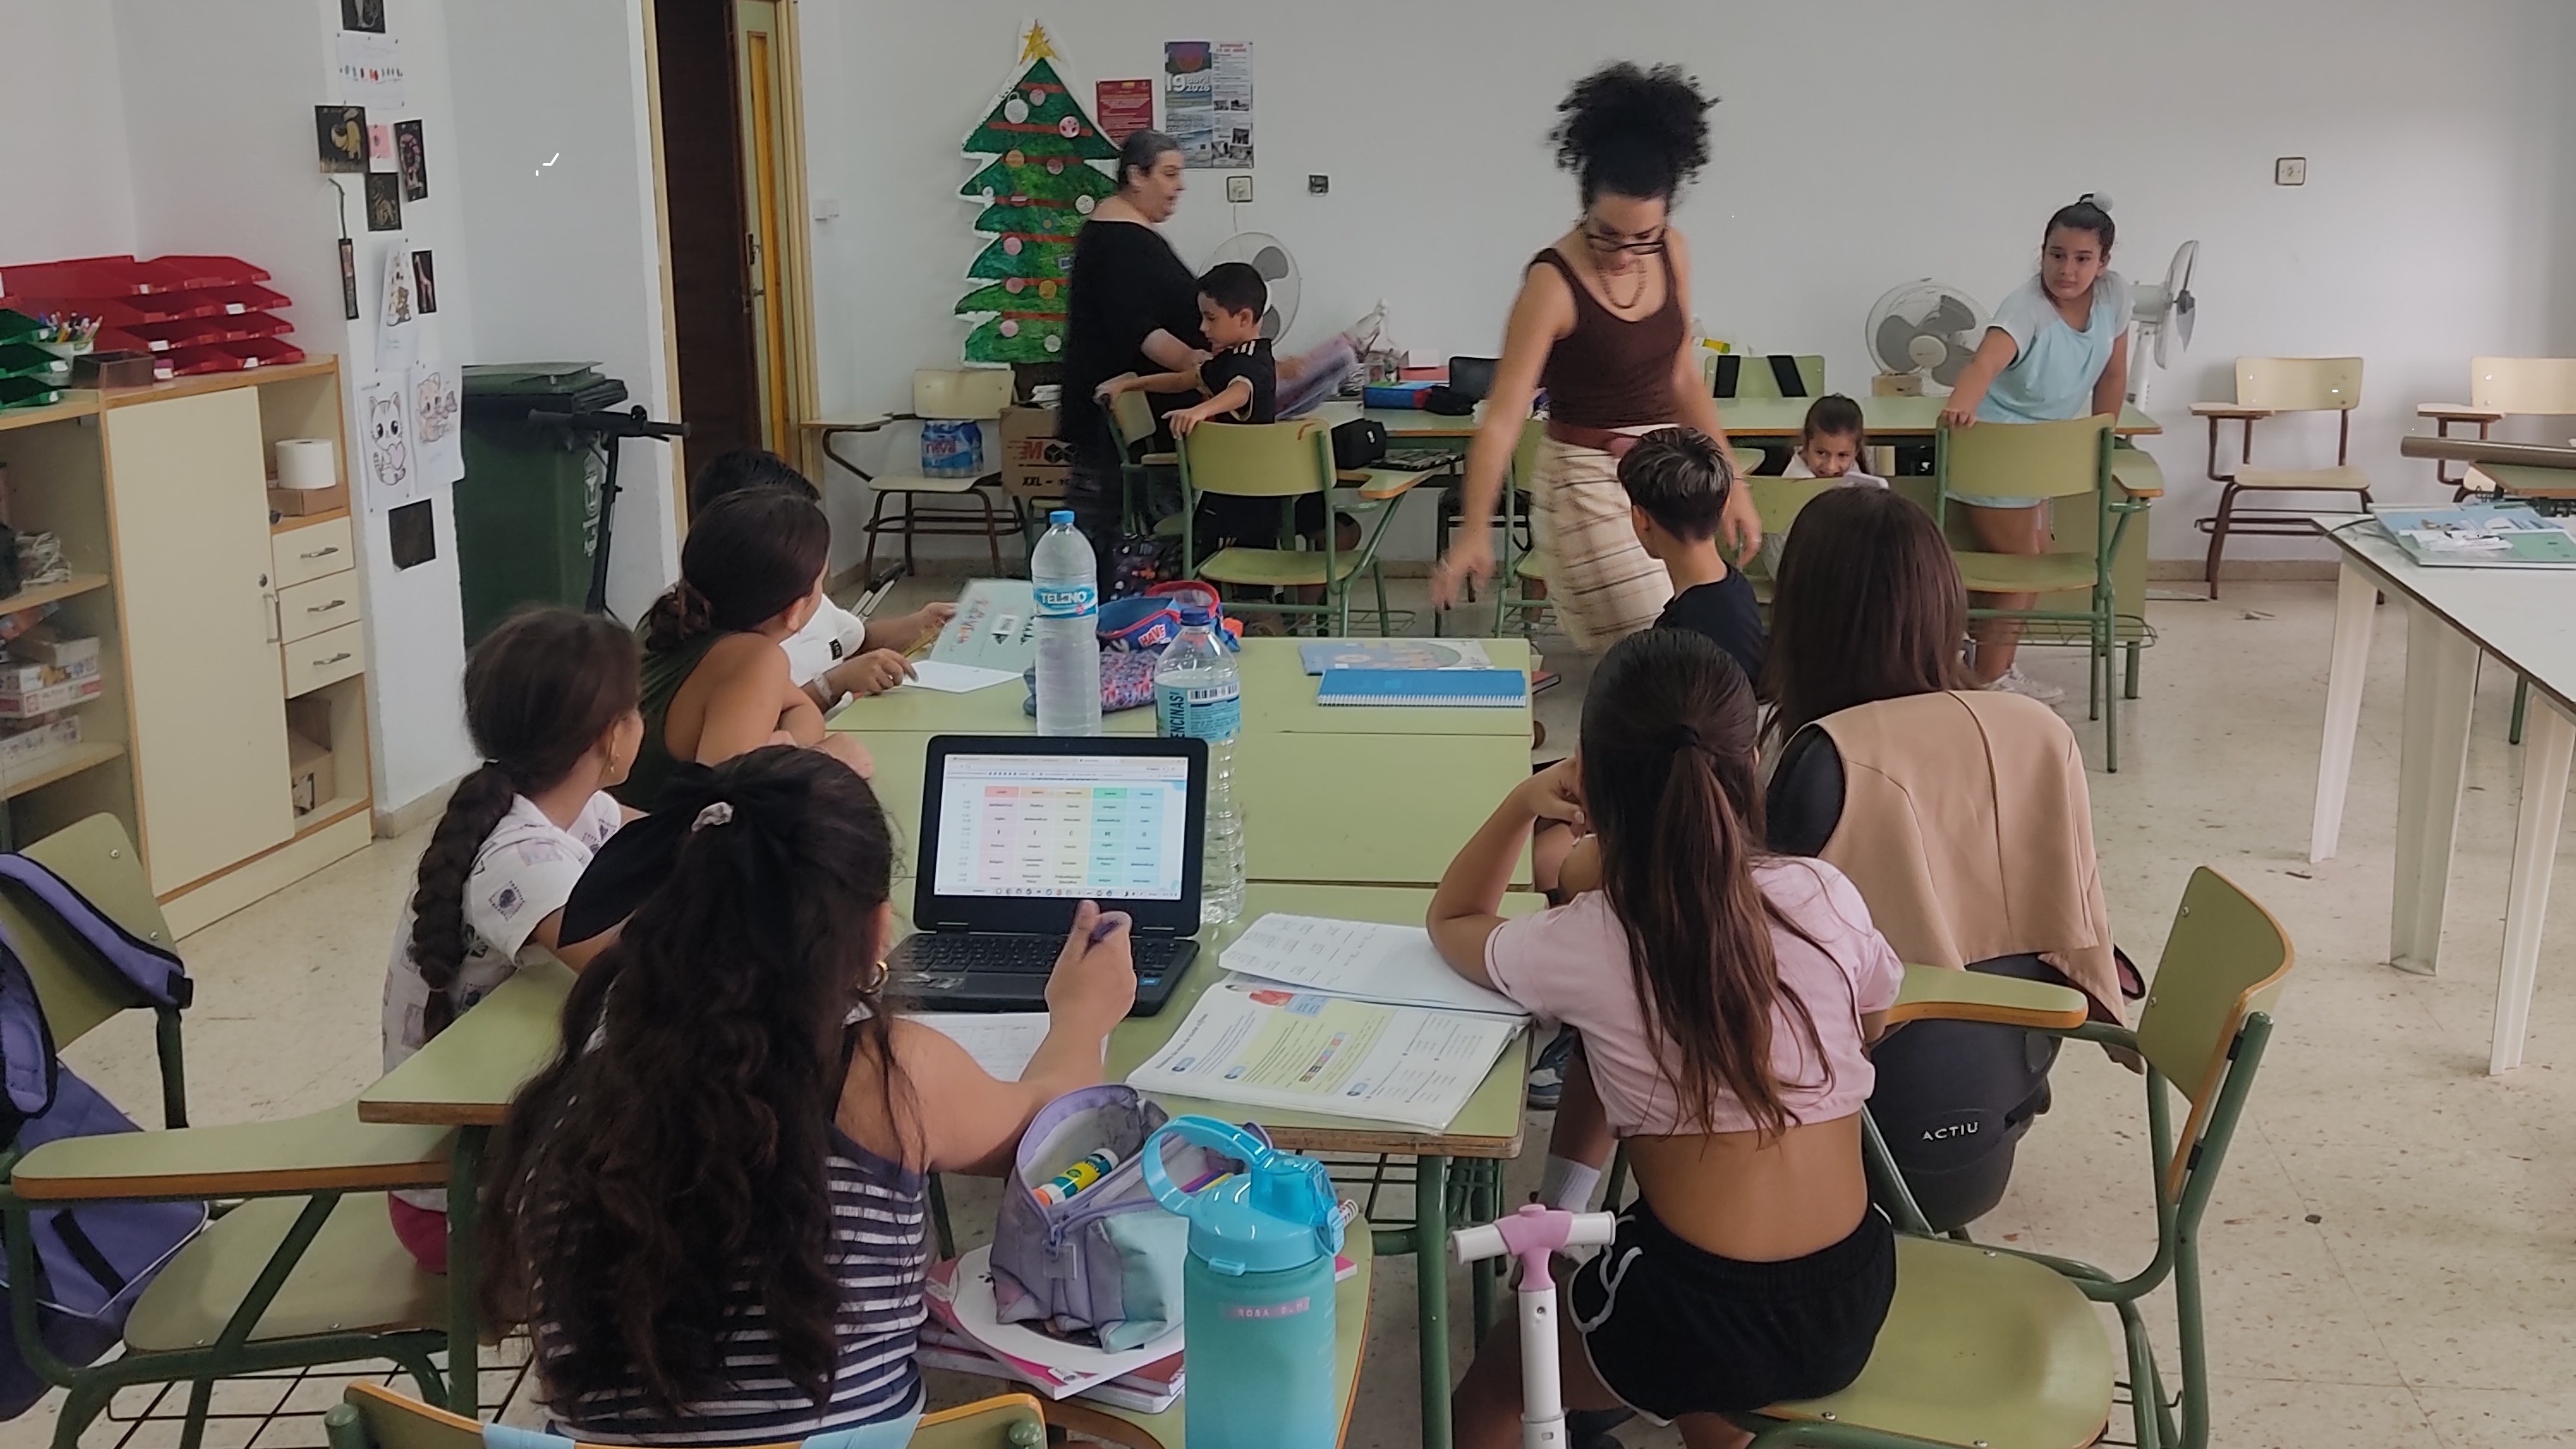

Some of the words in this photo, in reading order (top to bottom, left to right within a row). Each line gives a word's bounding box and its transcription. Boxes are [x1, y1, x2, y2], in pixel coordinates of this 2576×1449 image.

[1166, 73, 1186, 92] 19
[1139, 625, 1167, 646] HAVE
[1922, 1121, 1979, 1142] ACTIU
